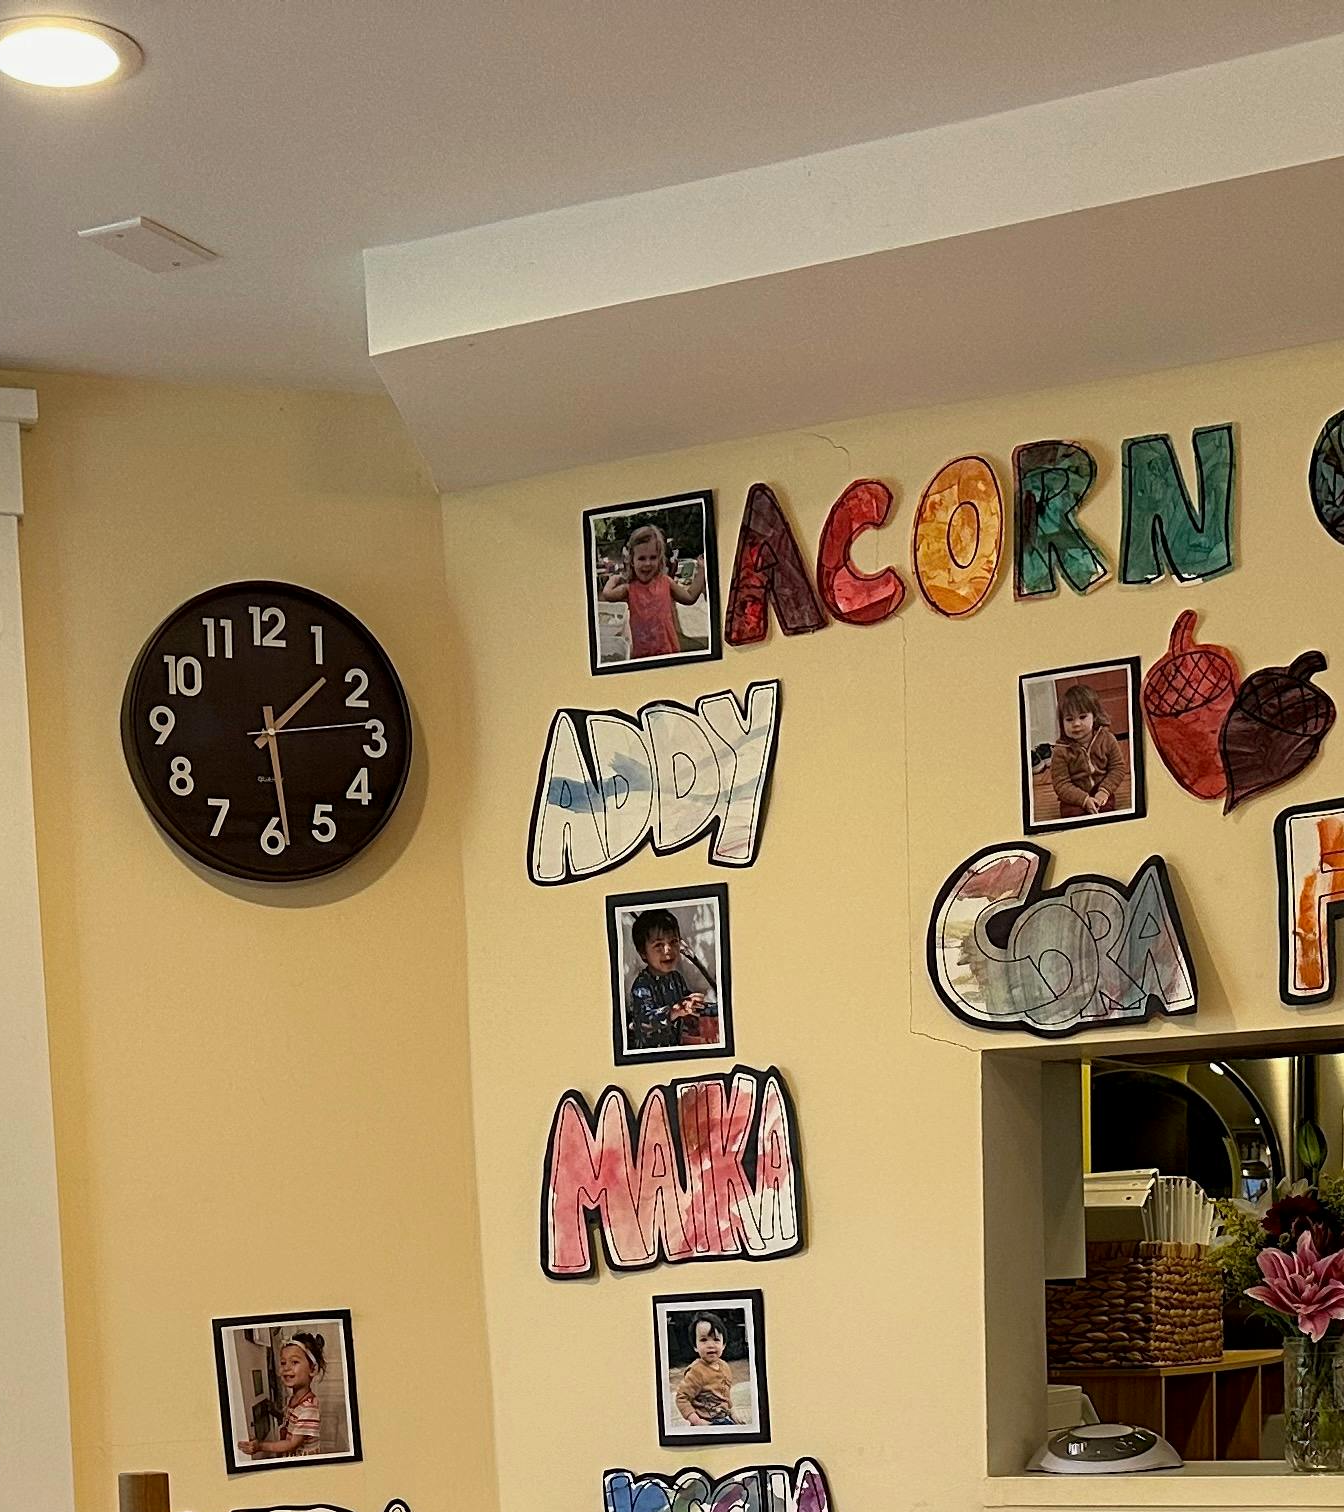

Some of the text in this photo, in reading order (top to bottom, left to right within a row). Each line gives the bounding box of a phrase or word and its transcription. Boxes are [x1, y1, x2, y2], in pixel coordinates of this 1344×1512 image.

[724, 422, 1236, 646] ACORN
[202, 617, 233, 659] 11
[248, 606, 287, 647] 12
[310, 625, 323, 665] 1
[163, 654, 203, 697] 10
[344, 668, 369, 708] 2
[149, 705, 176, 745] 9
[362, 719, 388, 759] 3
[169, 756, 195, 796] 8
[345, 767, 373, 805] 4
[532, 682, 778, 883] ADDY
[207, 798, 230, 837] 7
[260, 816, 286, 856] 6
[311, 804, 337, 843] 5
[930, 846, 1197, 1034] CORA
[545, 1069, 801, 1275] MAIKA
